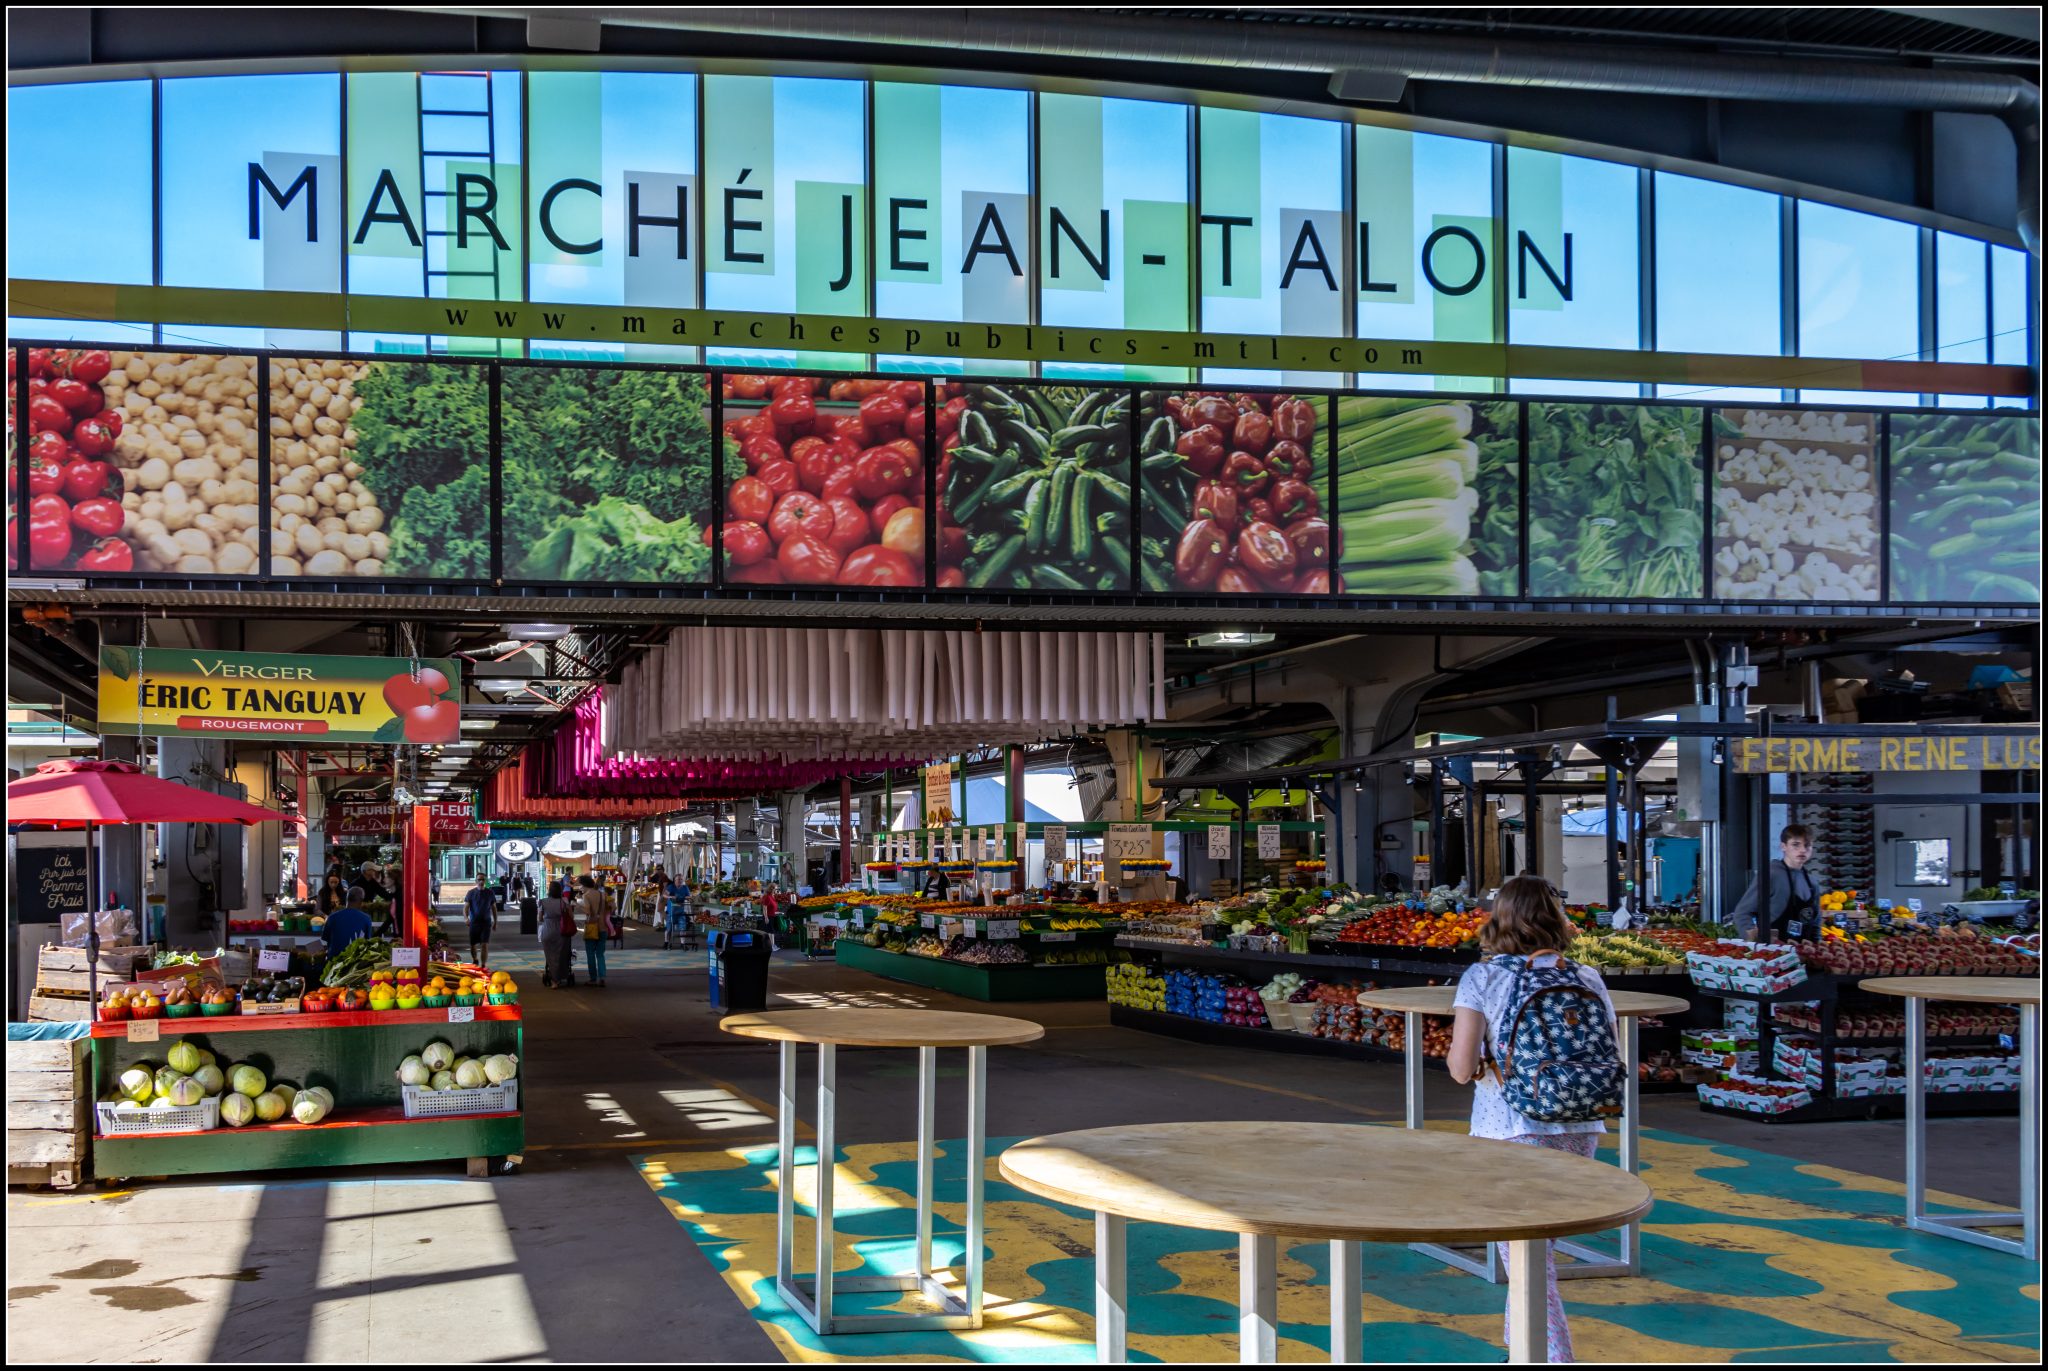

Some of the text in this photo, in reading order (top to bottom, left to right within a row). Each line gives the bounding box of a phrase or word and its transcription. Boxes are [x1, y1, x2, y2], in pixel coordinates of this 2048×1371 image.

[247, 162, 765, 265] MARCHÉ
[445, 307, 1423, 365] www.marchespublics-mtl.com
[141, 678, 366, 715] ÉRIC TANGUAY
[201, 719, 305, 732] ROUGEMONT
[1742, 737, 1861, 772] FERME
[1880, 736, 1969, 771] RENE
[342, 804, 411, 817] FLEURISTE
[340, 819, 364, 832] Chez
[39, 868, 59, 880] Pur
[59, 868, 75, 880] jus
[40, 879, 85, 894] Pomme
[47, 893, 84, 909] Frais
